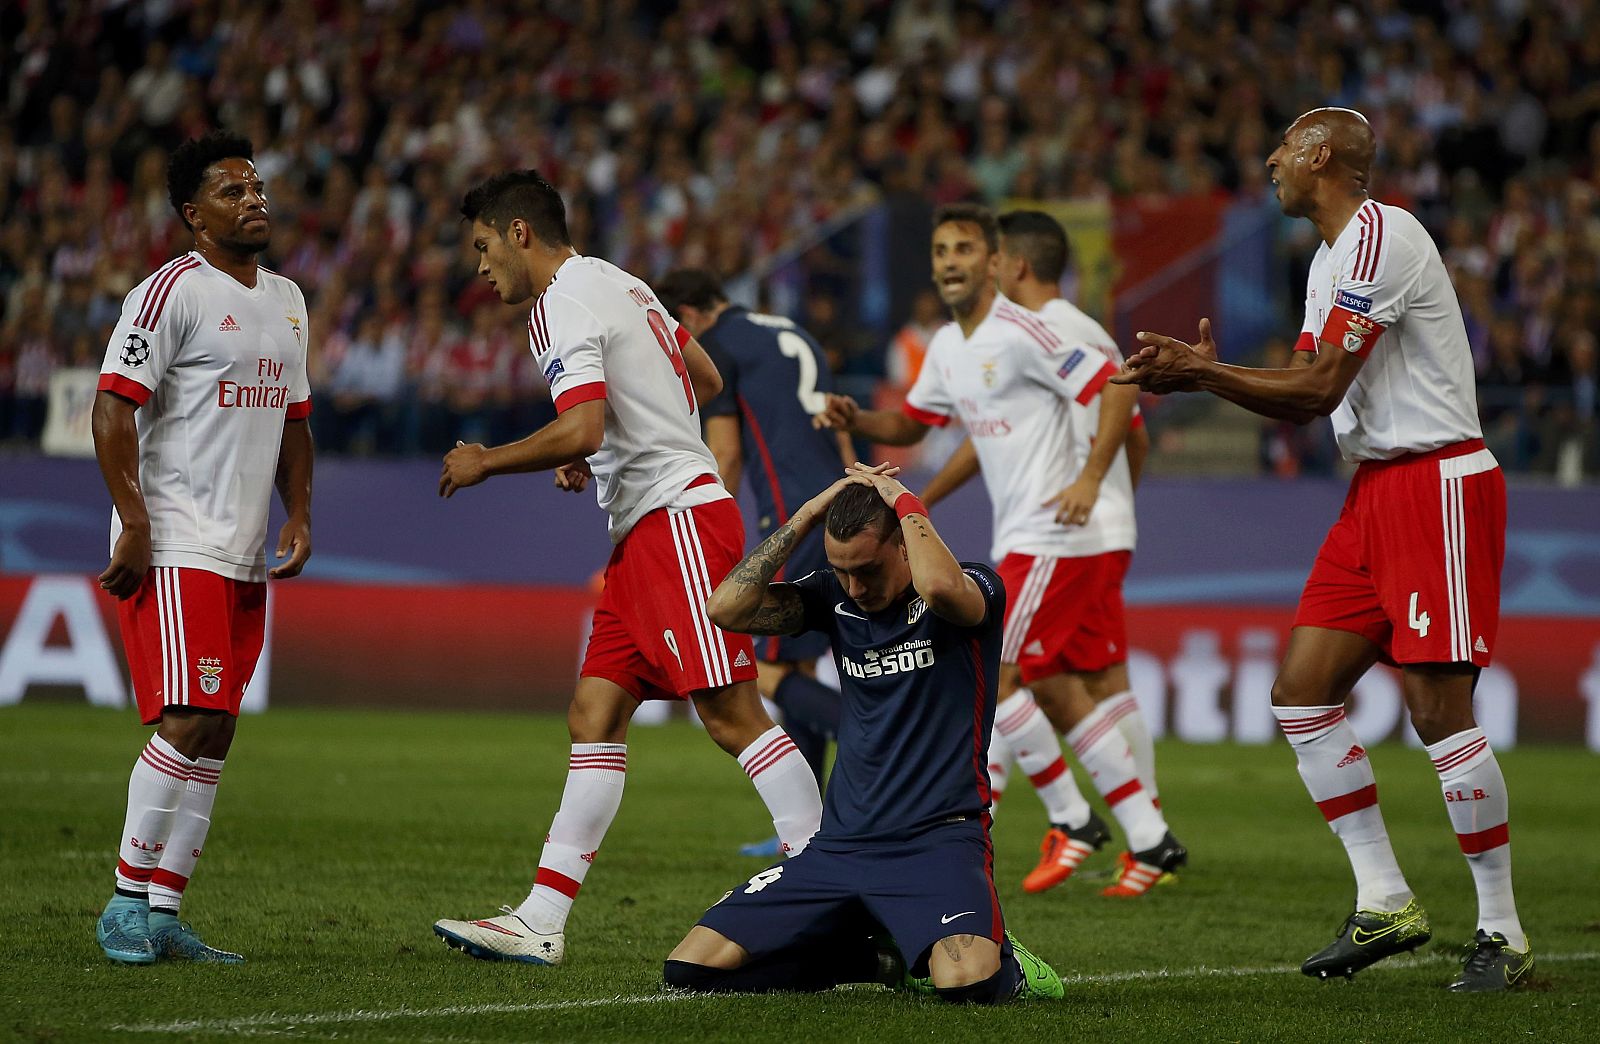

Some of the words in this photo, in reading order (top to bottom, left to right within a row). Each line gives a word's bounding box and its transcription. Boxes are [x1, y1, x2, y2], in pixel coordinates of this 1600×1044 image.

[1342, 296, 1371, 310] RESPECT
[257, 358, 284, 381] Fly
[646, 308, 695, 416] 9
[218, 379, 290, 409] Emirat
[970, 569, 995, 597] RESPECT
[1408, 592, 1431, 638] 4
[663, 629, 684, 672] 9
[879, 645, 904, 656] Trade
[903, 639, 932, 651] Online
[1445, 788, 1490, 803] S.L.B.
[743, 865, 784, 894] 4
